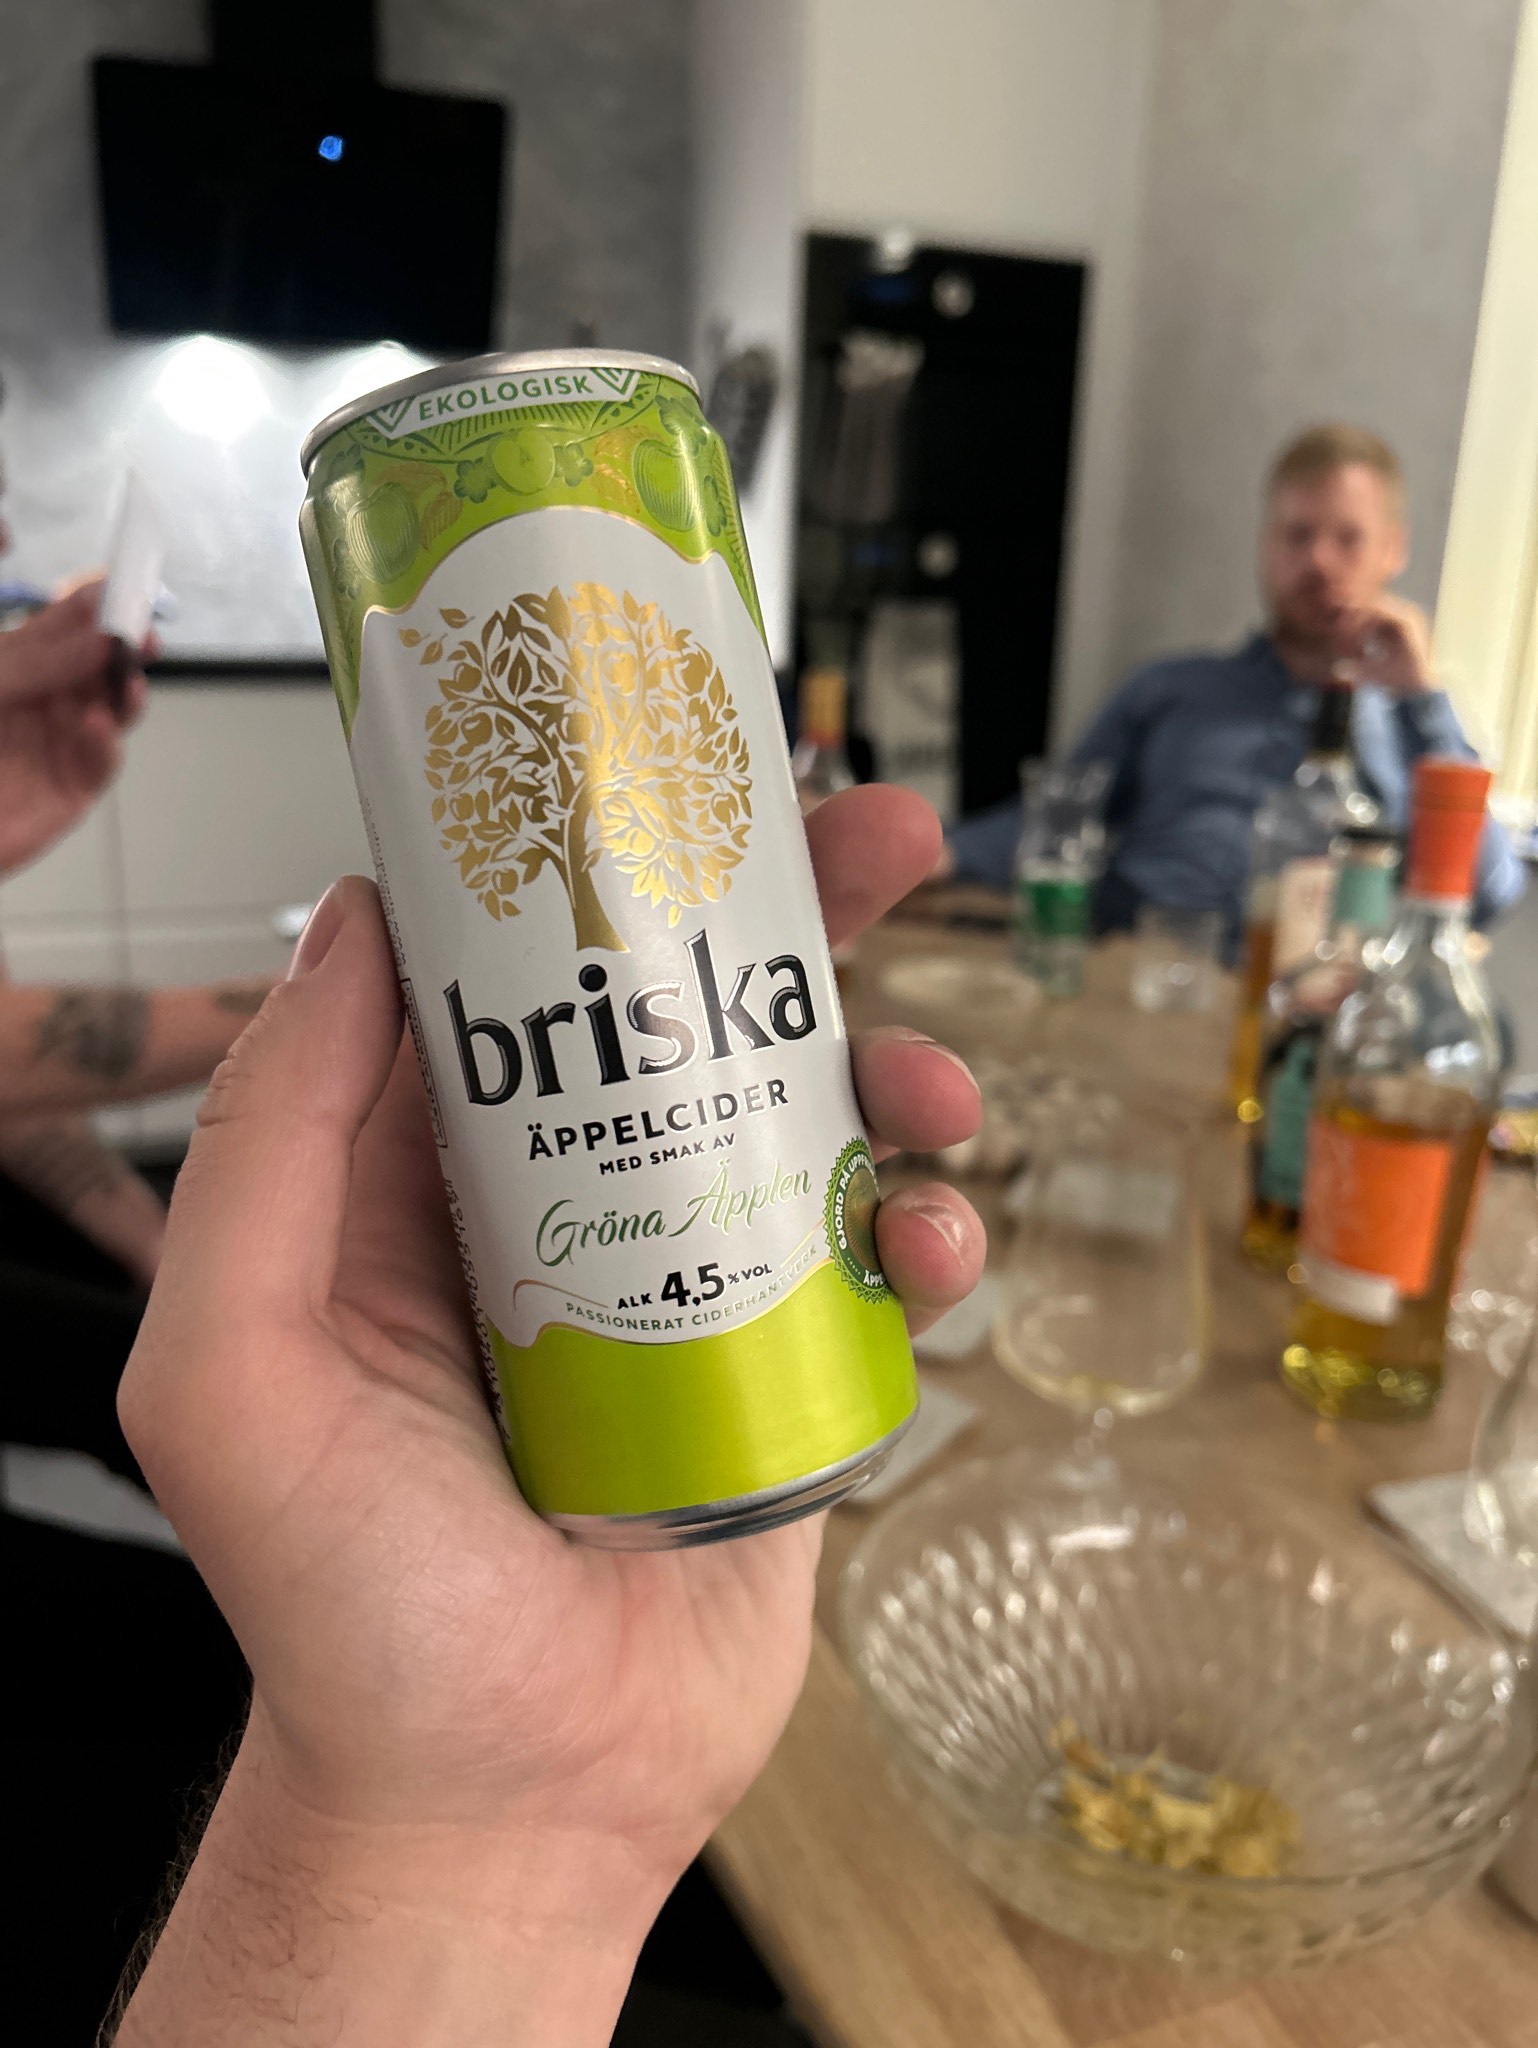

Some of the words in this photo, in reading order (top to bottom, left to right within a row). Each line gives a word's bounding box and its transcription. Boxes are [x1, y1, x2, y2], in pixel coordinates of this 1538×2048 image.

[419, 375, 593, 421] EKOLOGISK
[443, 928, 817, 1106] briska
[528, 1078, 789, 1161] ÄPPELCIDER
[599, 1156, 642, 1176] MED
[650, 1141, 706, 1166] SMAK
[713, 1133, 735, 1149] AV
[839, 1167, 851, 1191] PÅ
[535, 1199, 666, 1267] Gröna
[668, 1158, 812, 1236] Äpplen
[835, 1191, 848, 1251] GJORD
[566, 1302, 684, 1332] PASSIONERAT
[691, 1243, 818, 1326] CIDERHANTVERK
[617, 1292, 653, 1310] ALK
[660, 1262, 726, 1308] 4,5
[863, 1269, 886, 1287] ÄPPE
